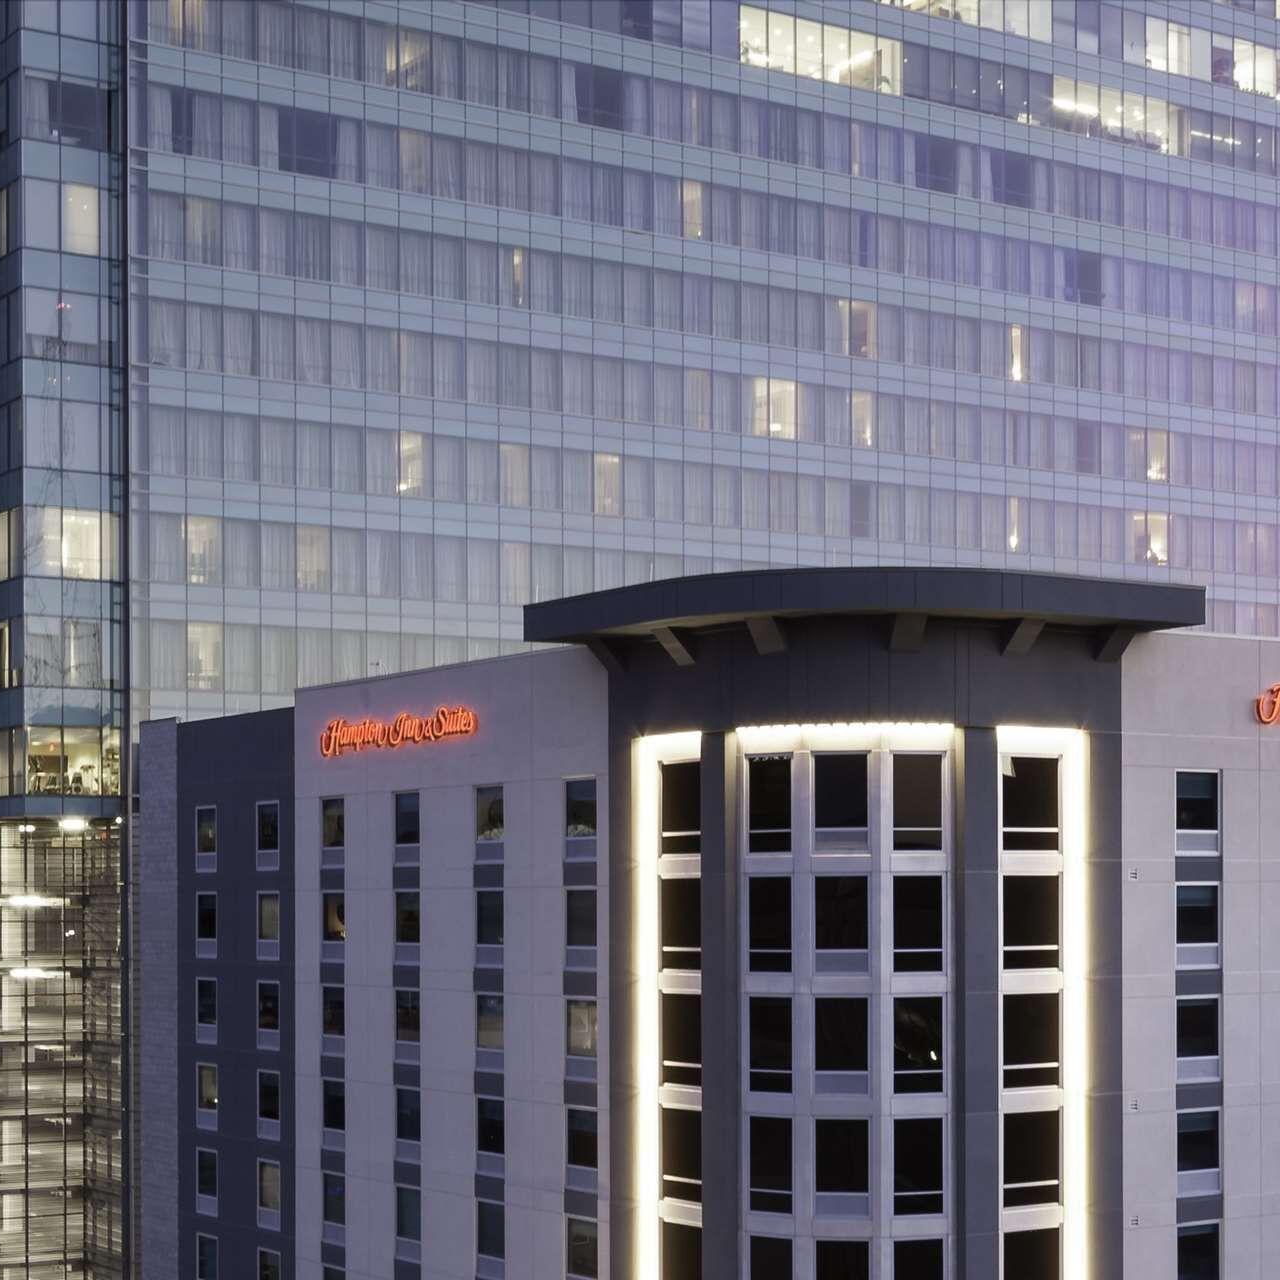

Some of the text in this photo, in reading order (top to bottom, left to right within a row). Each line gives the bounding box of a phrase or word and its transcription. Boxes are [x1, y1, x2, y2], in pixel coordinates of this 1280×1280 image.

[321, 719, 387, 756] Hampton
[388, 713, 426, 746] Inn
[434, 706, 476, 737] Suites
